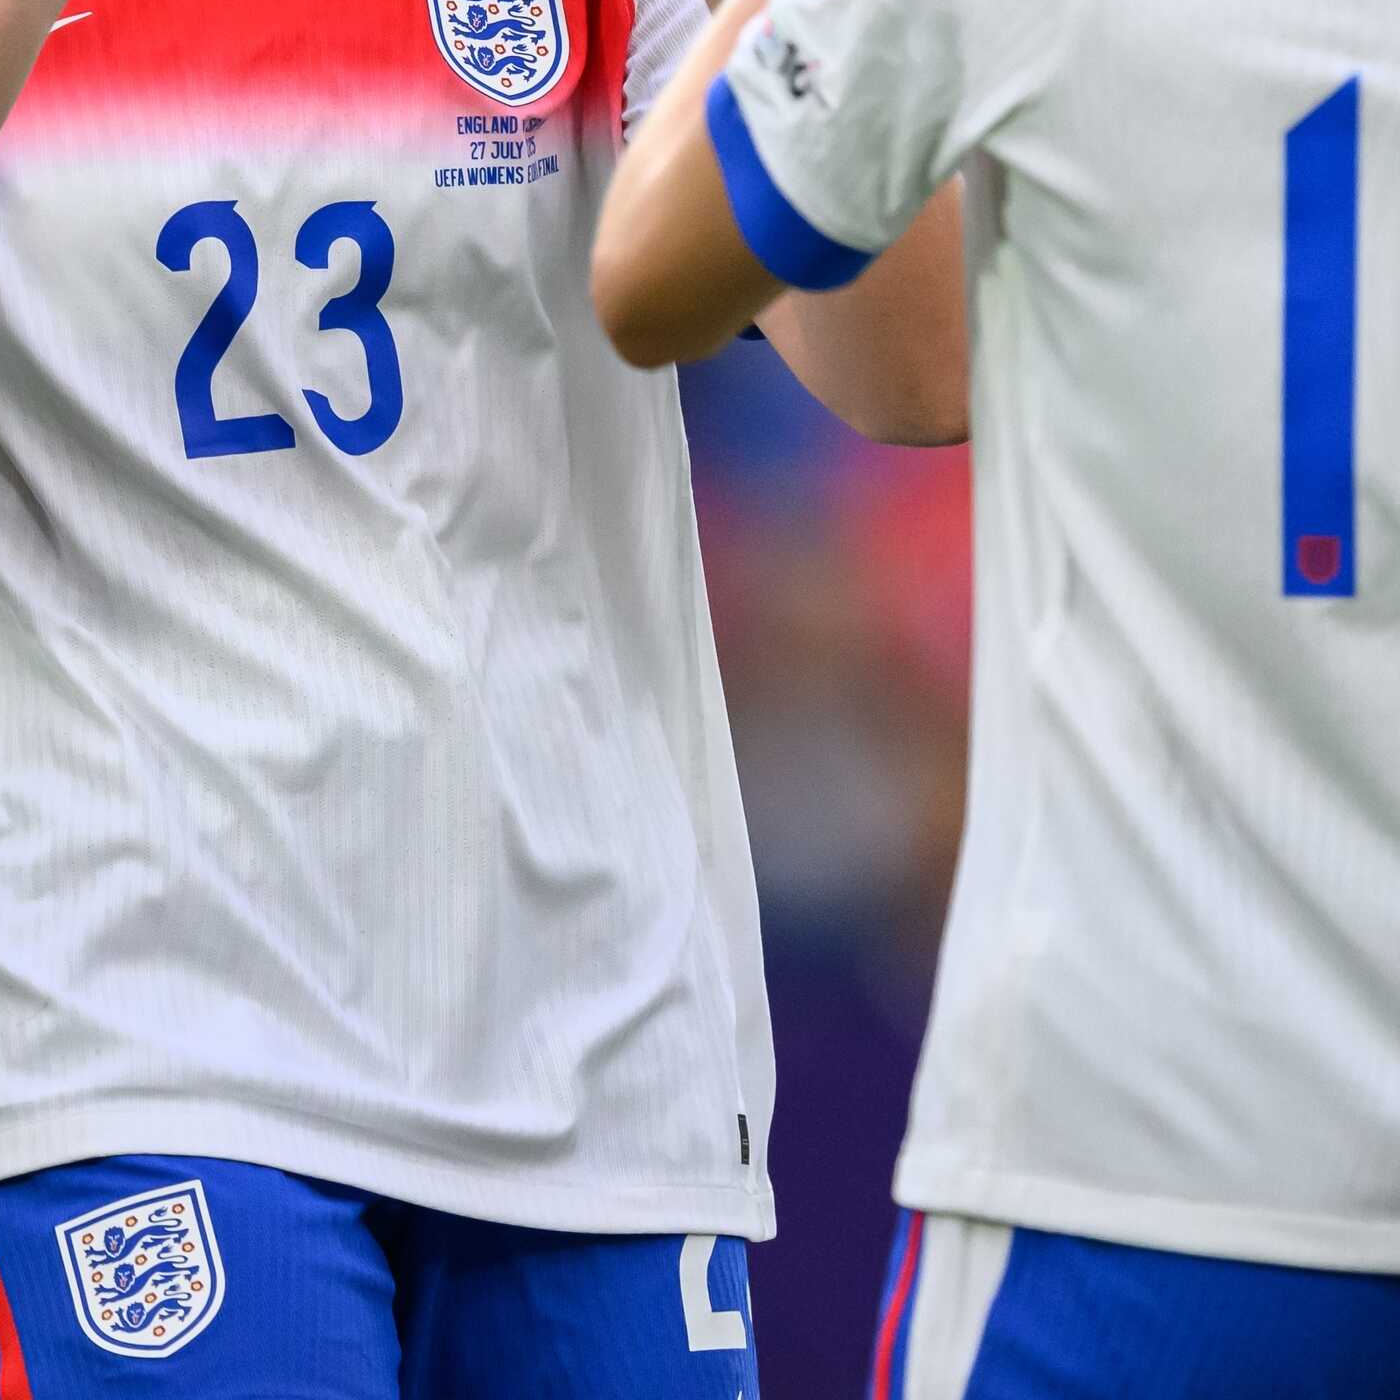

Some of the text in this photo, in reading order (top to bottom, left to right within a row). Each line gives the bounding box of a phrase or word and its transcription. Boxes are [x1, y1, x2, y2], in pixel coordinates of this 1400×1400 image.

[456, 115, 518, 135] ENGLAND
[469, 141, 486, 160] 27
[490, 141, 524, 160] JULY
[434, 168, 464, 188] UEFA
[466, 166, 524, 186] WOMENS
[538, 154, 560, 177] FINAL
[155, 199, 404, 460] 23
